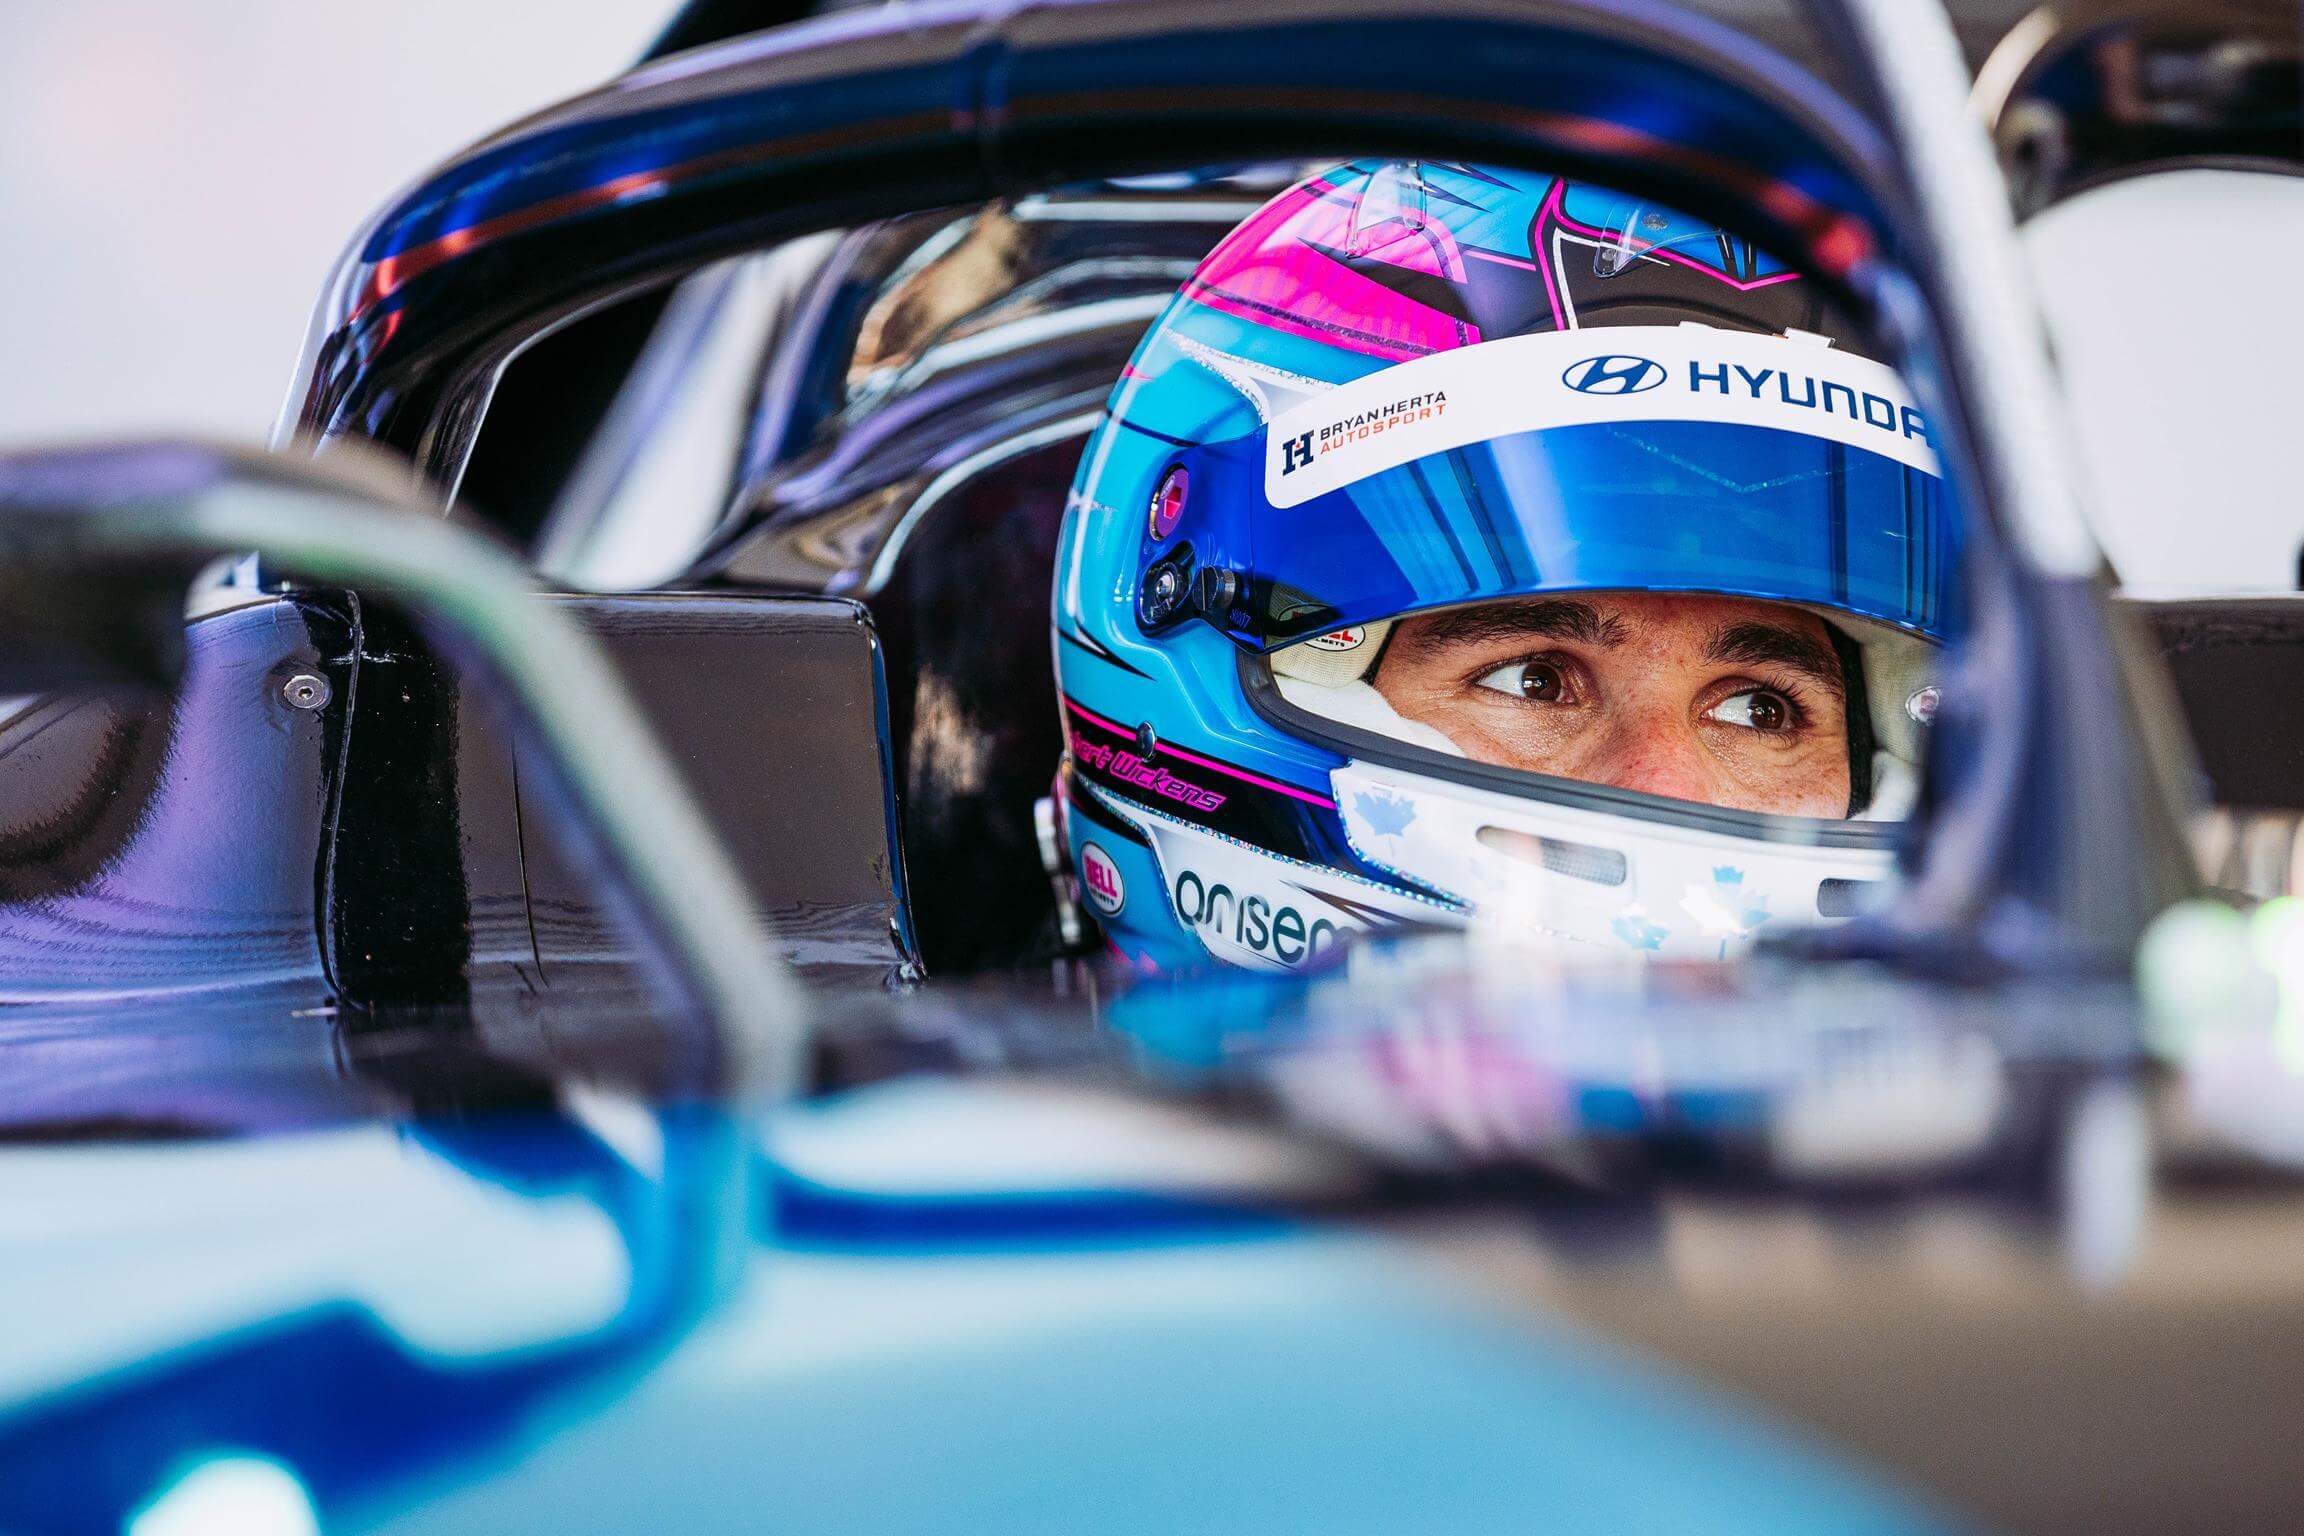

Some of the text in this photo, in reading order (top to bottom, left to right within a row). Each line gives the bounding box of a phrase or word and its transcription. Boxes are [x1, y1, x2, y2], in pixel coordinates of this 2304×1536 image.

[1320, 390, 1447, 441] BRYAN HERTA
[1320, 403, 1446, 455] AUTOSPORT
[1690, 361, 1937, 449] HYUNDA
[1109, 750, 1227, 813] Wickens
